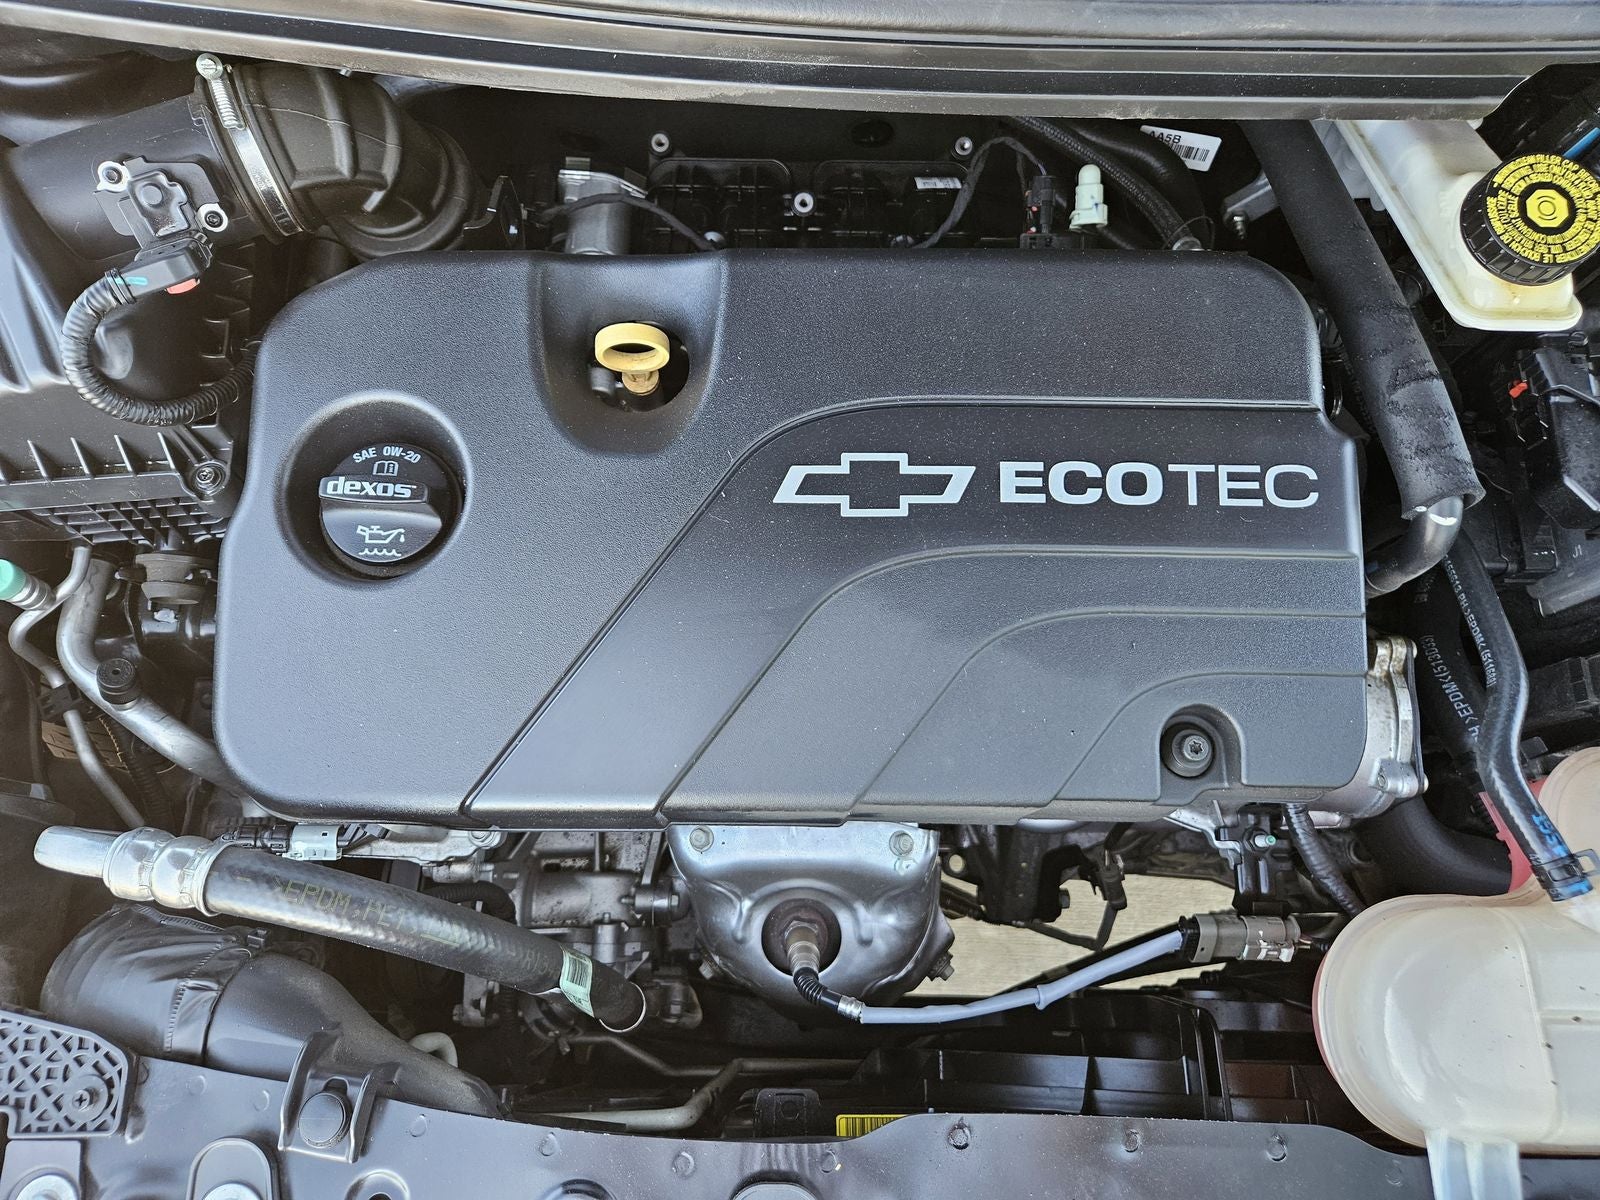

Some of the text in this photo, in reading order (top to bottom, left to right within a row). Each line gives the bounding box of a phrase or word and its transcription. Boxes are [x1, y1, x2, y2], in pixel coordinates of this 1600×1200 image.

[1562, 159, 1580, 173] CAP
[353, 445, 422, 464] SAE 0W-20
[326, 476, 412, 498] dexos
[1000, 460, 1319, 508] ECOTEC
